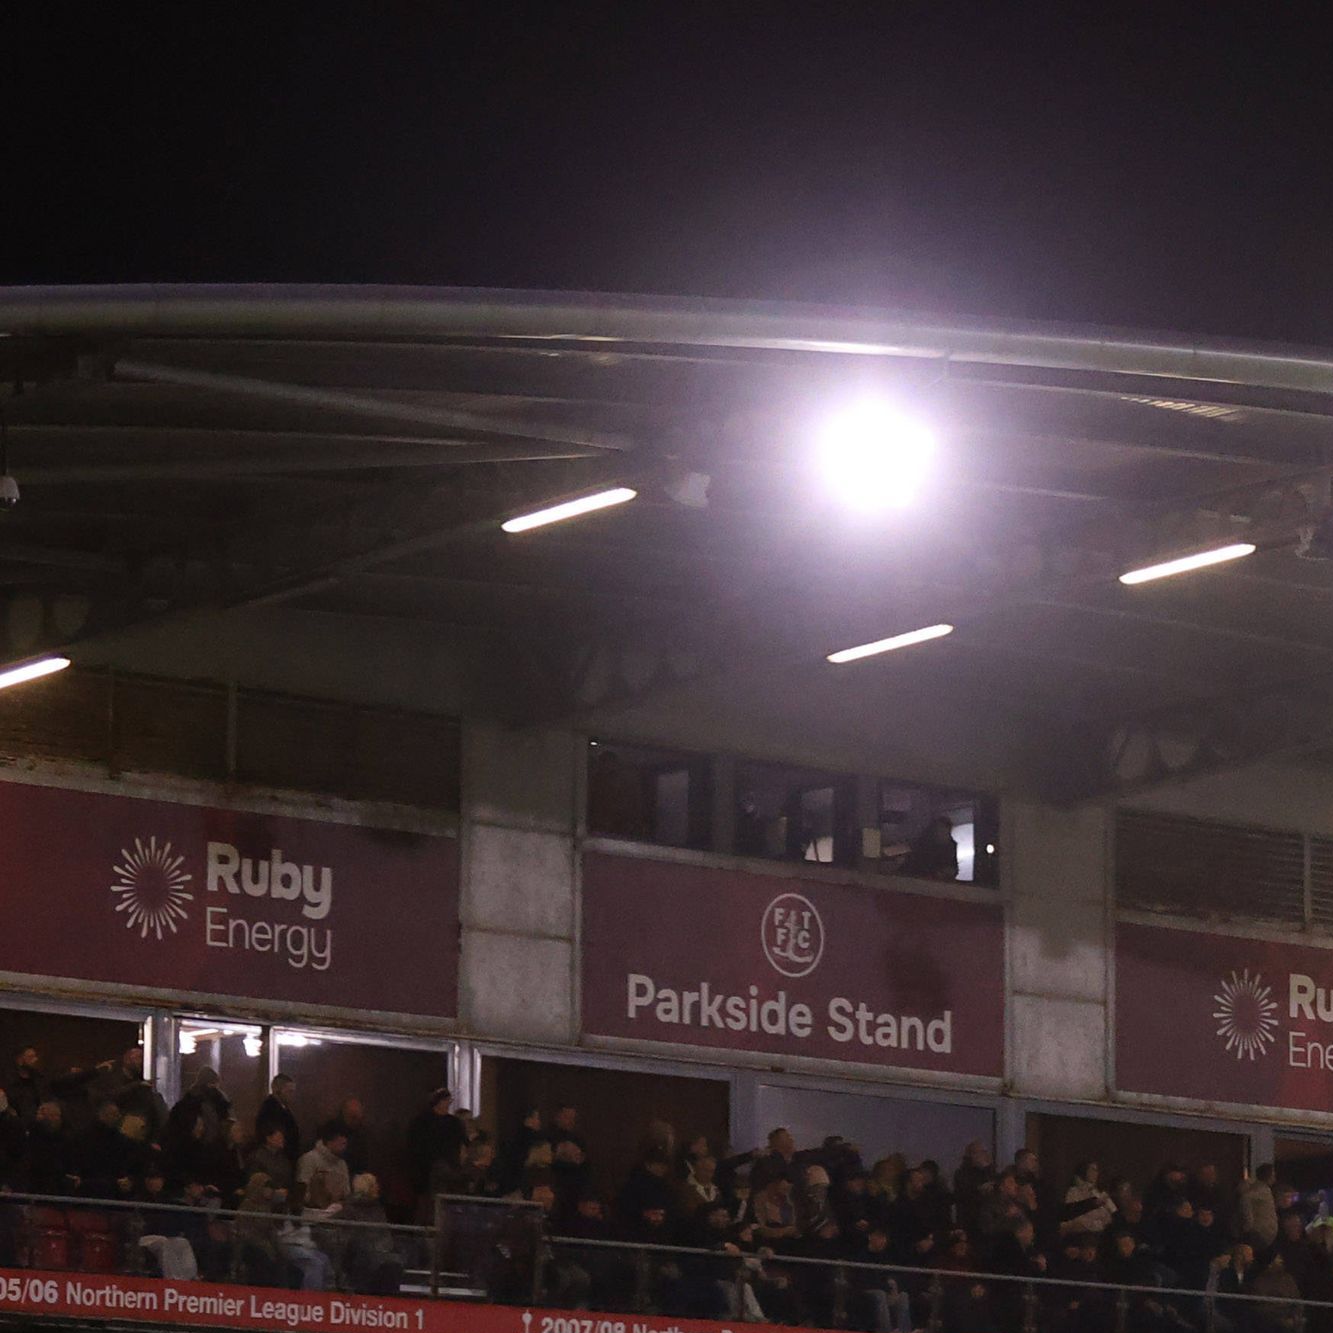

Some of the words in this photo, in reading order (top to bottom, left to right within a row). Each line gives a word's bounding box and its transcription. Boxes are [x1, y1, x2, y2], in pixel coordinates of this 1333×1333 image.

[206, 842, 332, 919] Ruby
[206, 907, 332, 970] Energy
[627, 974, 812, 1037] Parkside
[828, 998, 953, 1054] Stand
[66, 1283, 158, 1311] Northern
[165, 1289, 244, 1317] Premier
[251, 1296, 324, 1326] League
[330, 1301, 408, 1329] Division
[415, 1308, 425, 1331] 1
